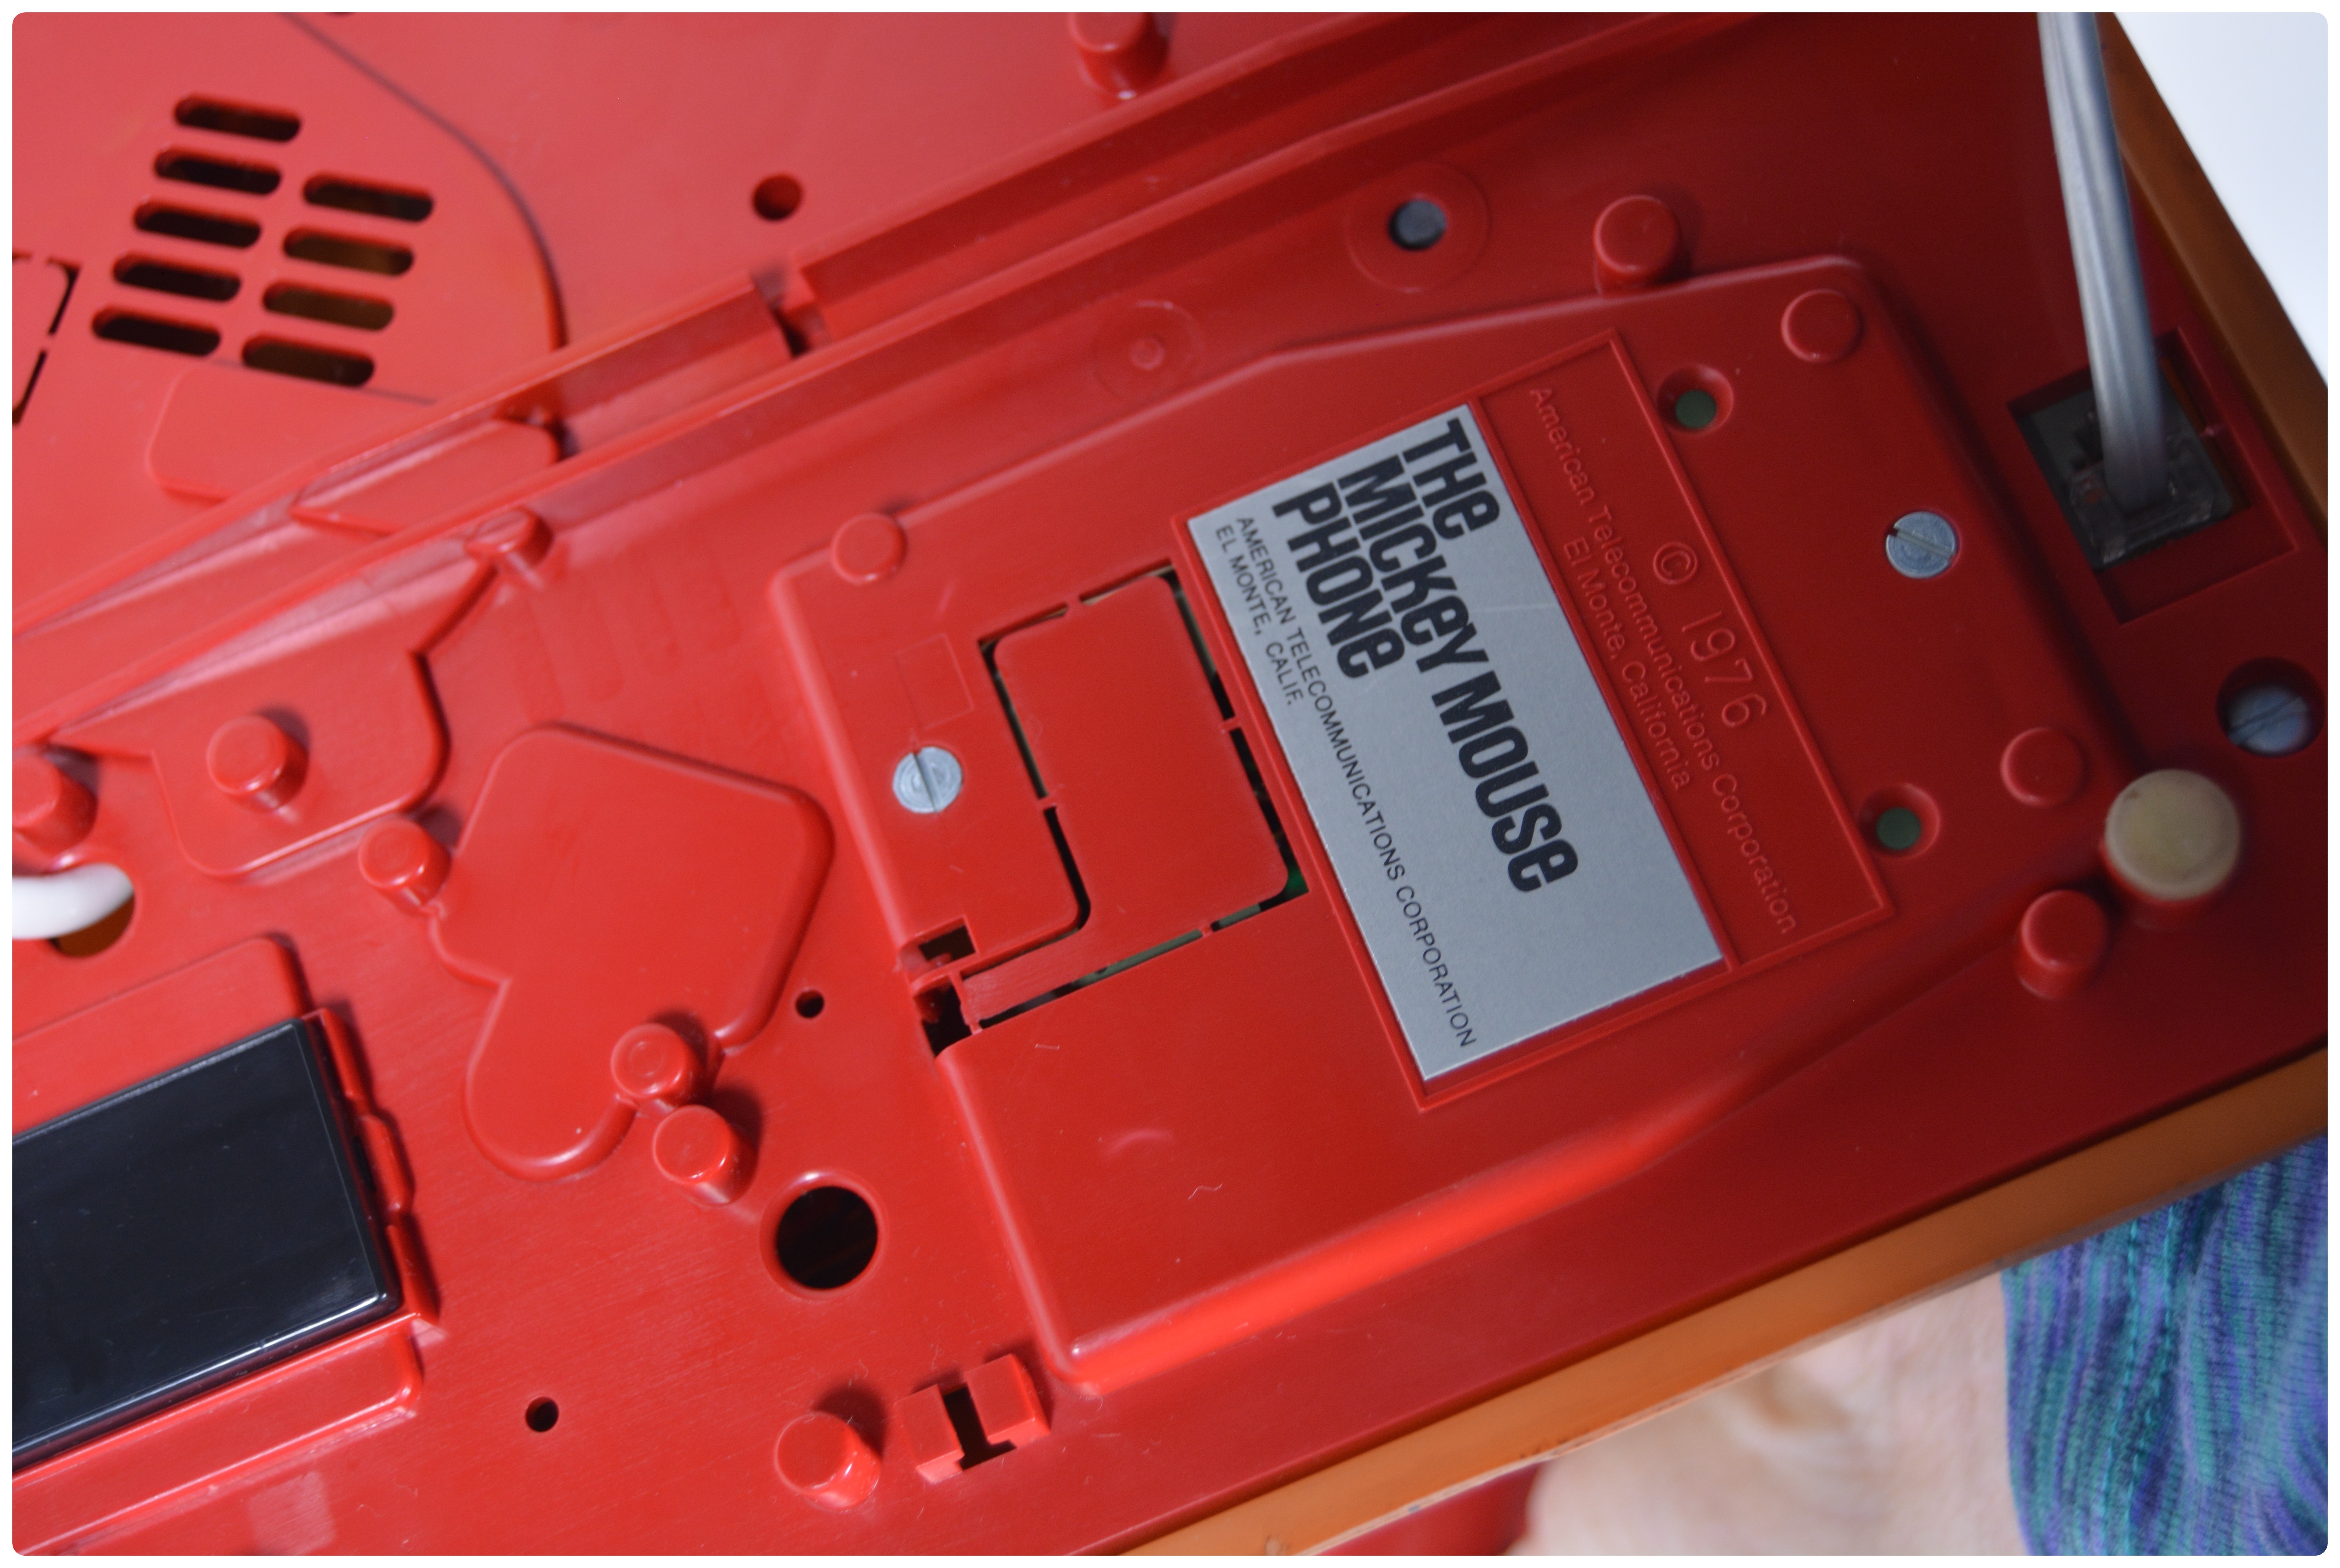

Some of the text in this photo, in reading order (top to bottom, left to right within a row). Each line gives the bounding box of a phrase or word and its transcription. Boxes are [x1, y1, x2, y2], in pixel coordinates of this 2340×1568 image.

[1216, 525, 1304, 705] EL MONTE, CALIF.
[1530, 388, 1796, 934] American Telecommunications Corporation
[1564, 537, 1690, 789] El Monte, California
[1682, 611, 1767, 727] 1976
[1237, 517, 1477, 1048] AMERICAN TELECOMMUNICATIONS CORPORATION
